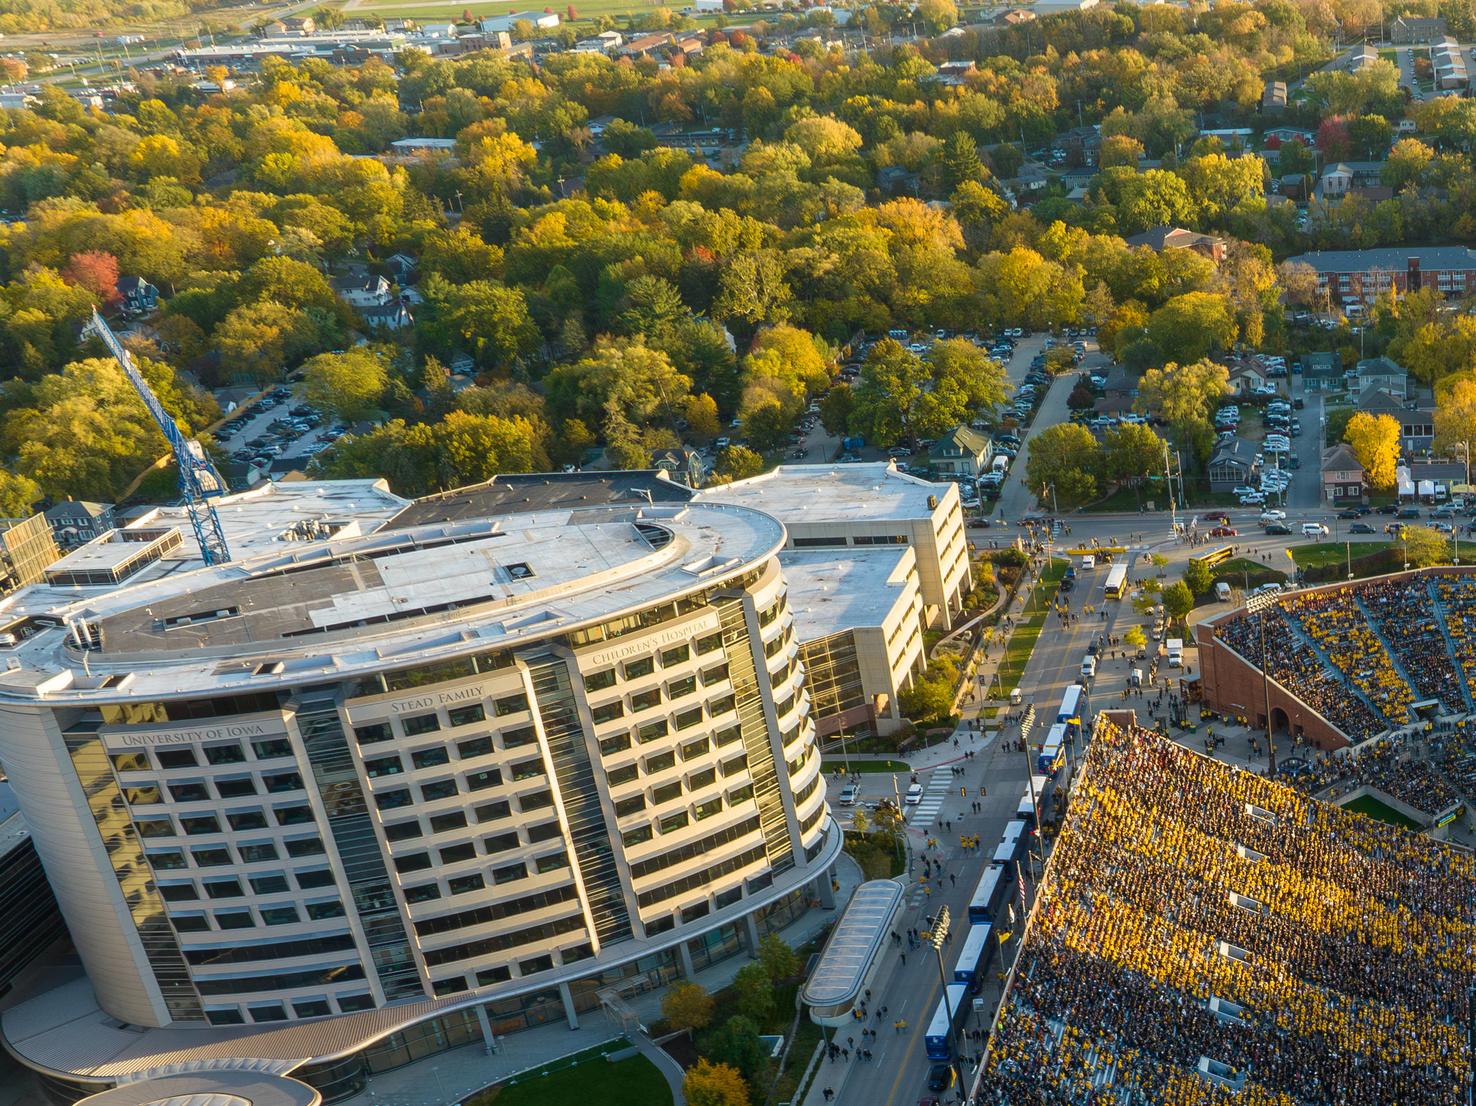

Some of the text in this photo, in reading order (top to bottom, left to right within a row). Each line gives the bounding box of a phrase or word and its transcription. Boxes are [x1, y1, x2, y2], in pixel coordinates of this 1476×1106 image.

[592, 620, 708, 665] CHILDREN'S HOSPITAL
[391, 686, 482, 713] STEAD FAMILY
[122, 725, 264, 746] UNIVERSITY OF IOWA
